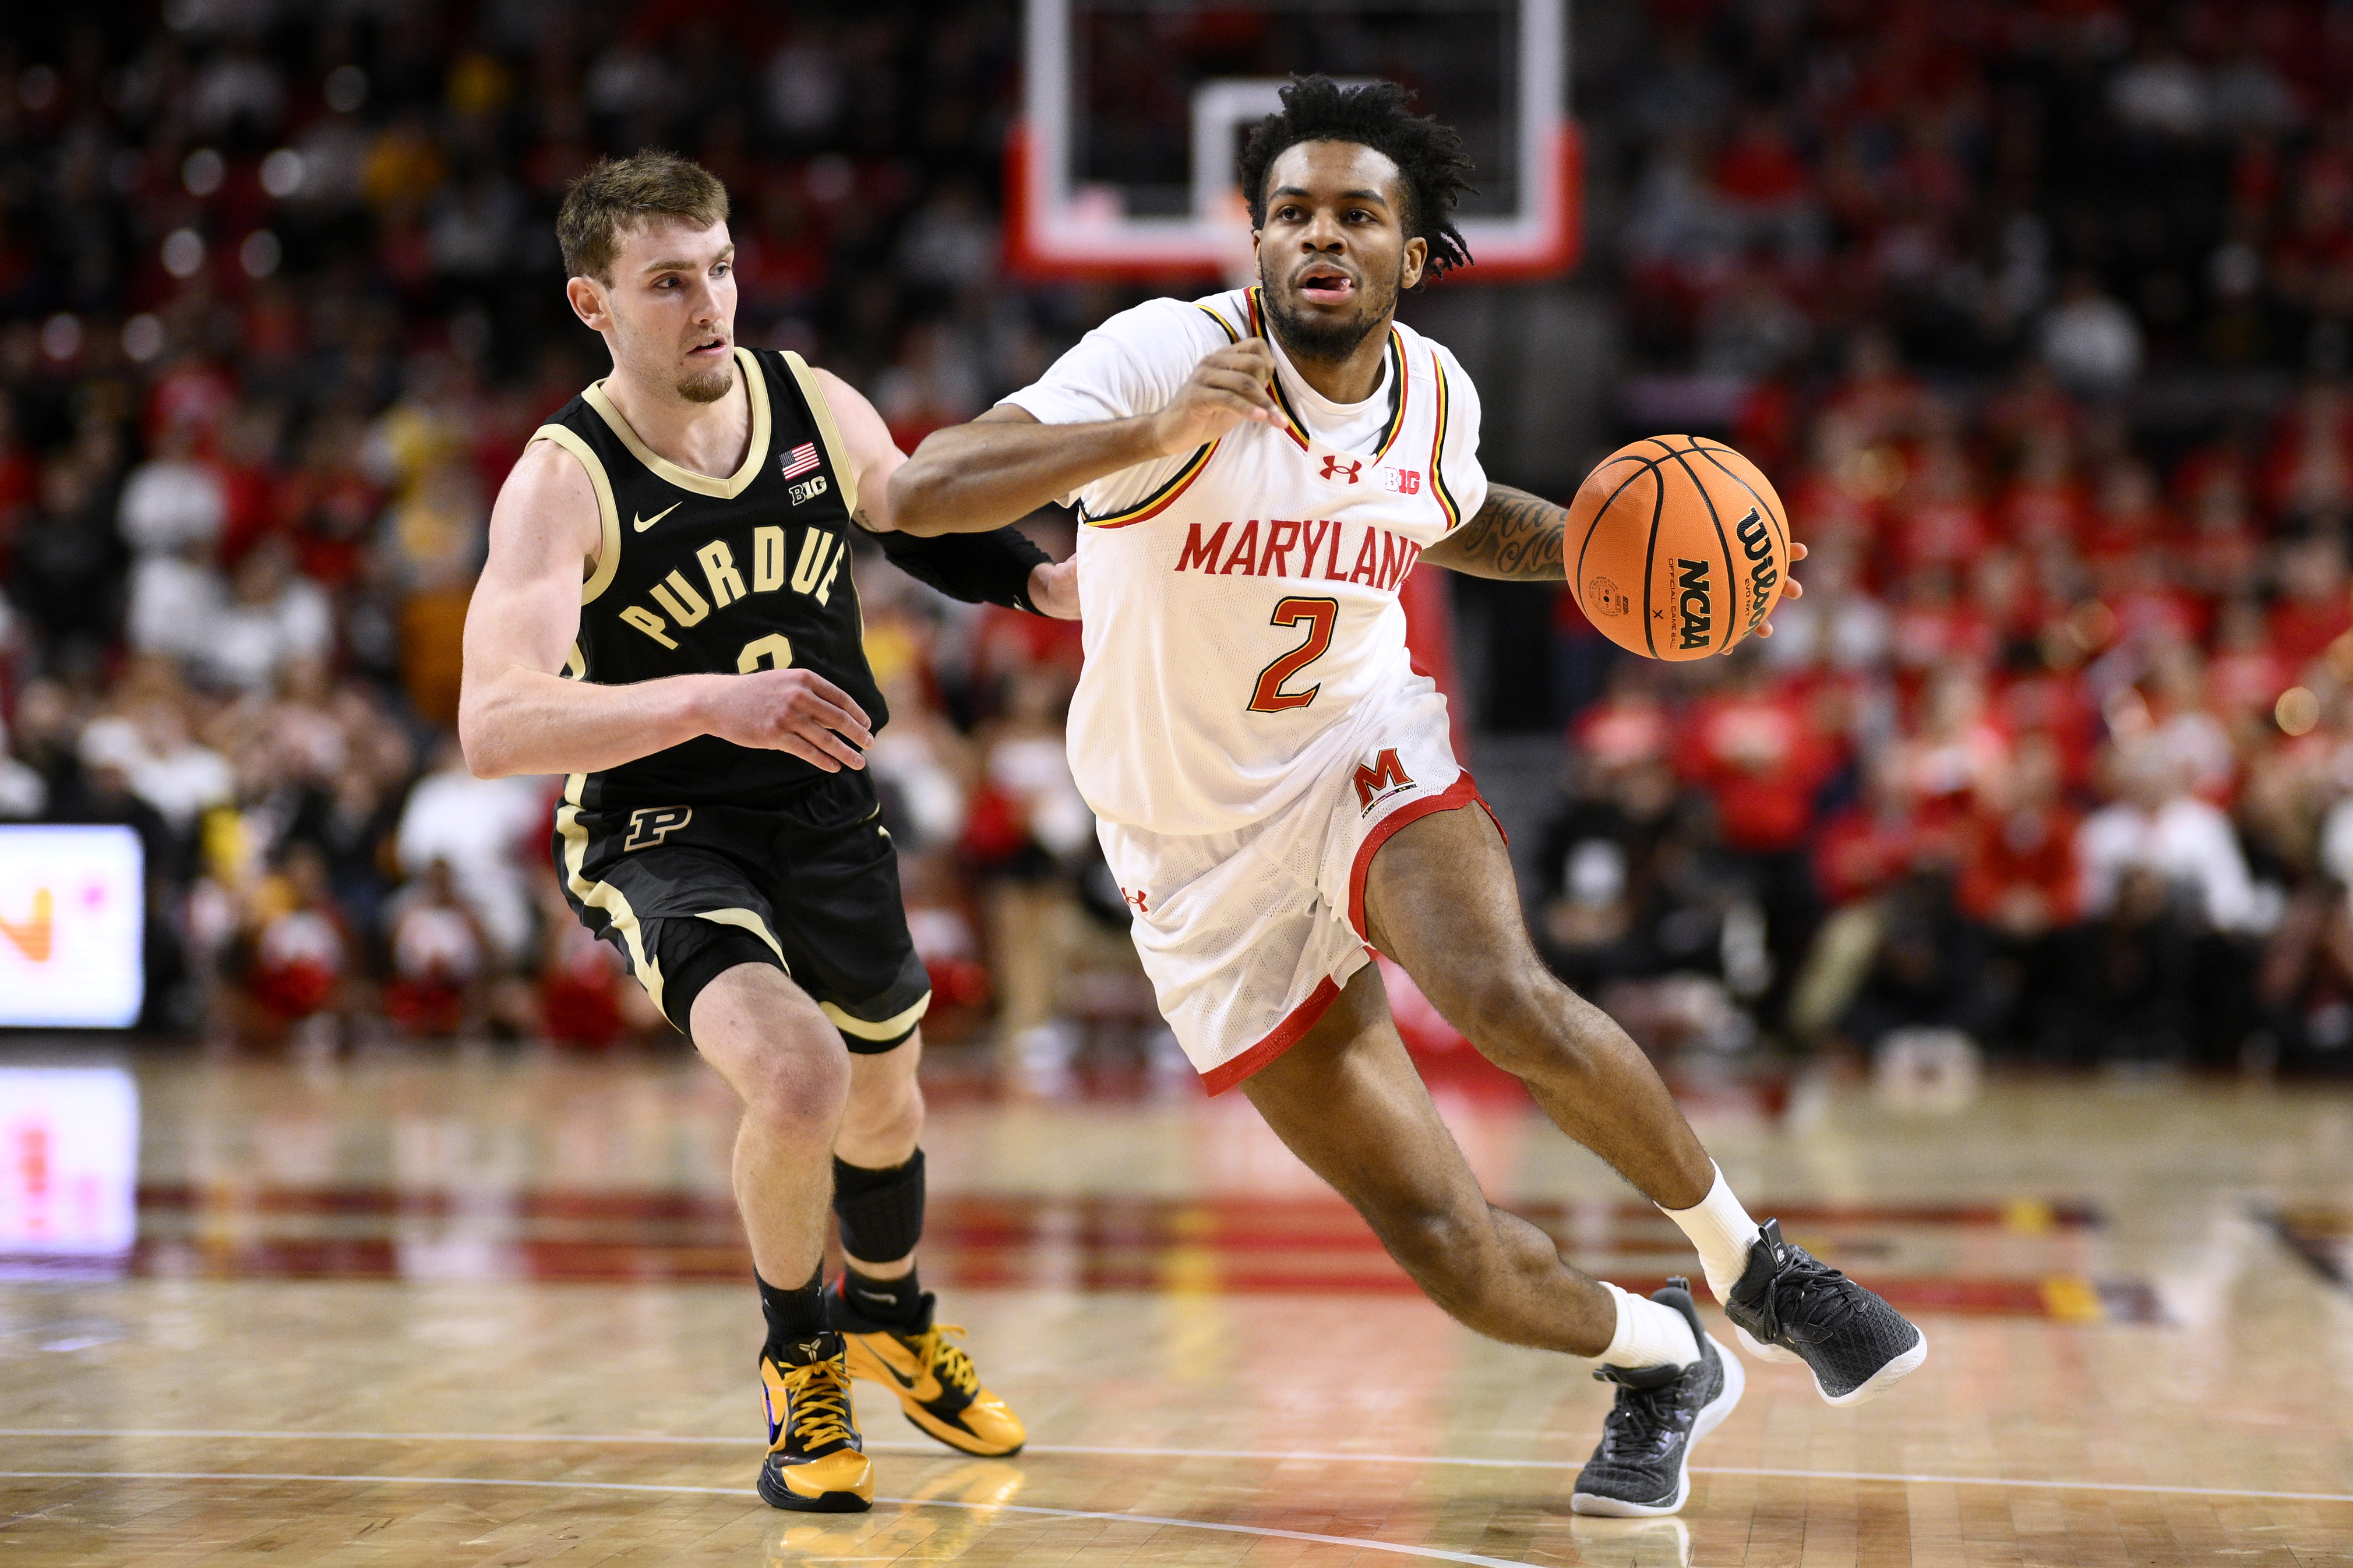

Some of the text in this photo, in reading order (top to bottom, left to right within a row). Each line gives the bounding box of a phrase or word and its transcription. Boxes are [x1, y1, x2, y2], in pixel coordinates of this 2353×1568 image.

[1677, 557, 1712, 650] NCAA
[1246, 596, 1339, 713] 2
[1352, 747, 1414, 813] M
[624, 804, 692, 852] P
